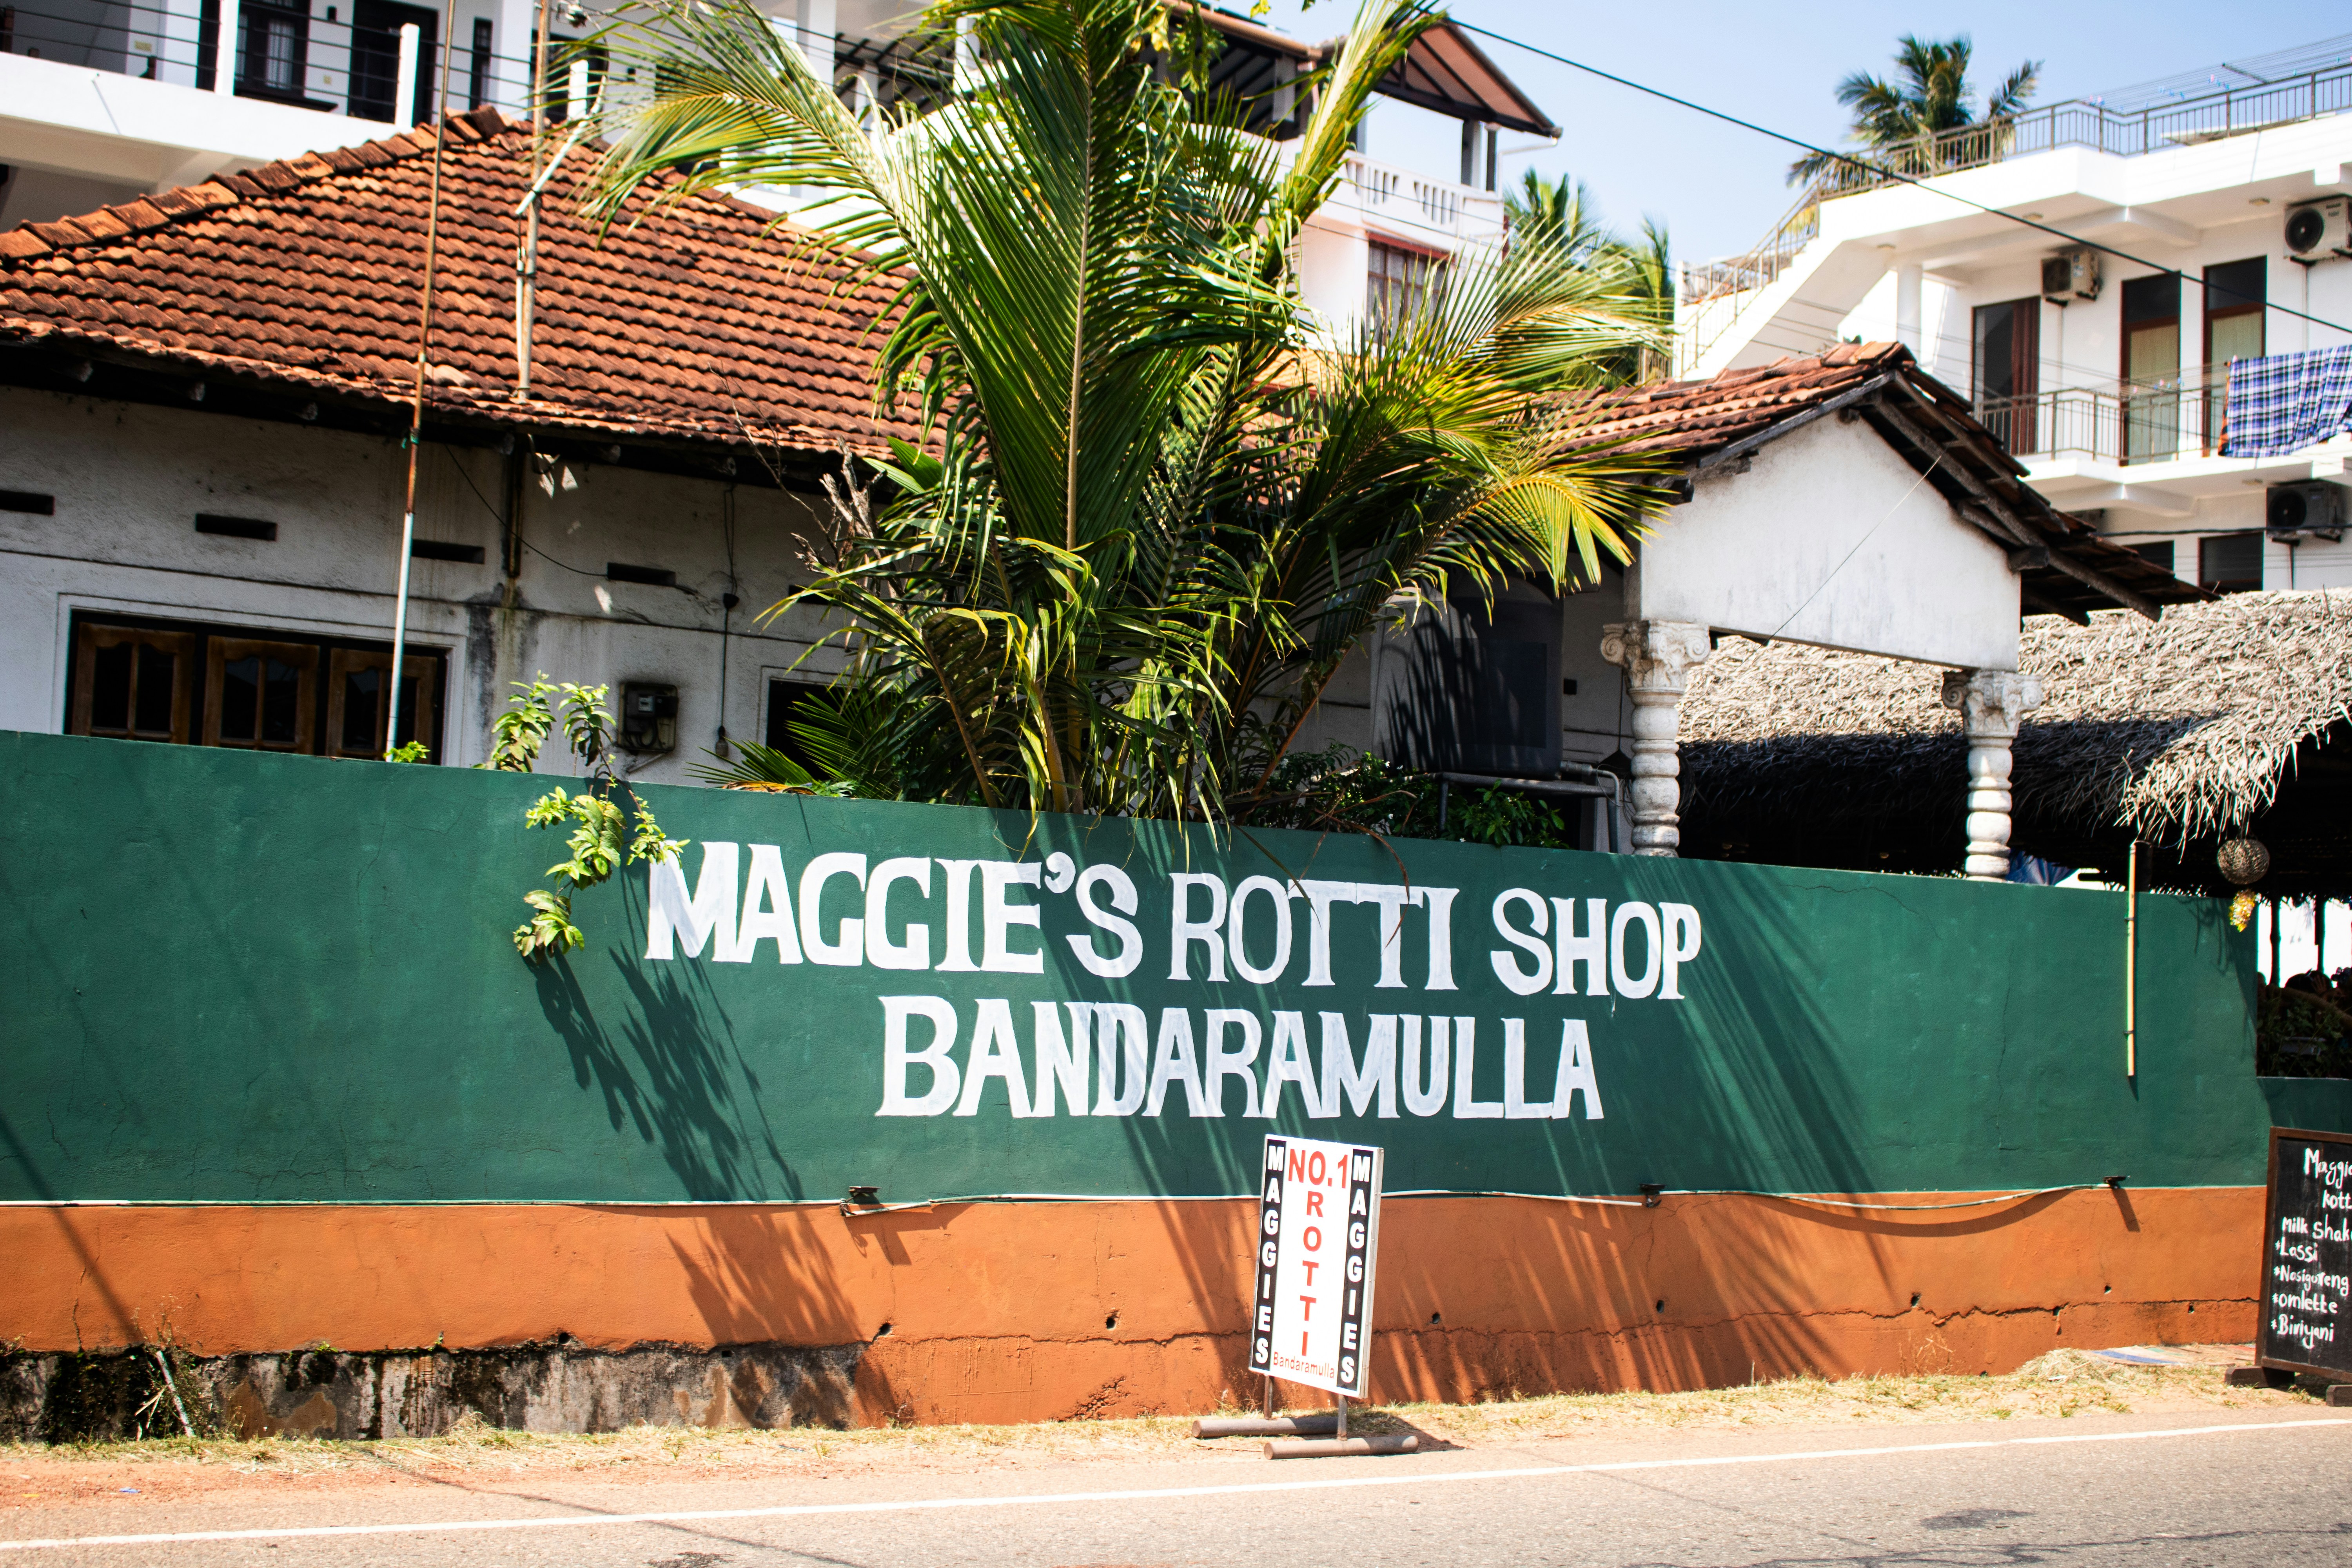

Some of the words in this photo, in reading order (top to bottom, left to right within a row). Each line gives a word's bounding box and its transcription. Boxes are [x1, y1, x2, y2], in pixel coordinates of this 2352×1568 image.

[643, 840, 1143, 977] MAGGIE'S
[1167, 873, 1460, 990] ROTTI
[1490, 888, 1701, 1000] SHOP
[875, 995, 1604, 1120] BANDARAMULLA
[1255, 1145, 1284, 1364] MAGGIES
[1299, 1191, 1323, 1356] ROTTI
[1341, 1156, 1370, 1384] MAGGIES
[2282, 1216, 2308, 1234] Milk
[2312, 1214, 2352, 1242] Shak
[1273, 1351, 1335, 1379] Bandaramulla
